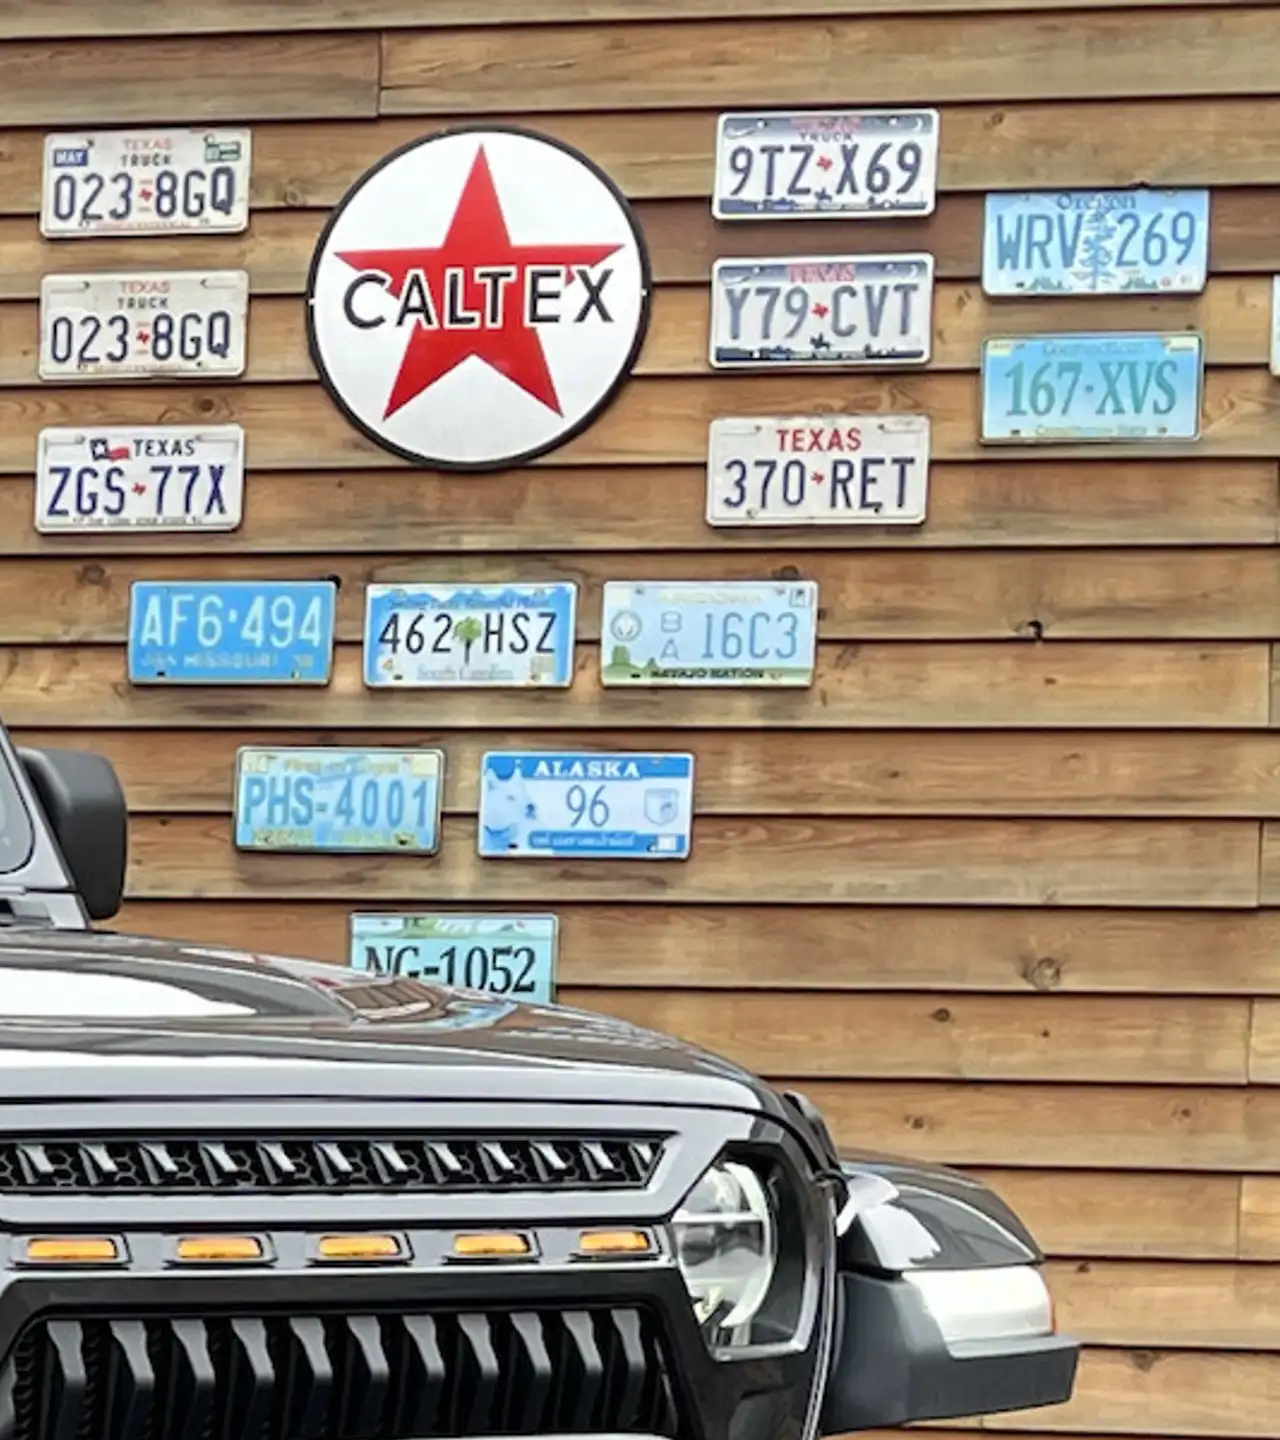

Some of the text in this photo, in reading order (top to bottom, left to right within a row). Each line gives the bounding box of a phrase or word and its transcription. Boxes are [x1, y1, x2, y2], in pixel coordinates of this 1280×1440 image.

[121, 155, 172, 166] TRUCK
[123, 138, 172, 150] TEXAS
[729, 141, 922, 196] 9TZ X69
[54, 166, 235, 222] 023 8GQ
[996, 211, 1195, 271] WRV 269
[117, 297, 169, 309] TRUCK
[120, 281, 171, 293] TEXAS
[342, 267, 615, 330] CALTEX
[724, 283, 919, 340] Y79 CVT
[51, 310, 231, 364] 023 8GQ
[132, 439, 195, 457] TEXAS
[777, 427, 862, 452] TEXAS
[47, 464, 226, 517] ZGS 77X
[724, 457, 915, 509] 370 RET
[378, 611, 558, 655] 462 HSZ
[702, 611, 800, 660] 16C3
[533, 760, 641, 778] ALASKA
[566, 784, 610, 828] 96
